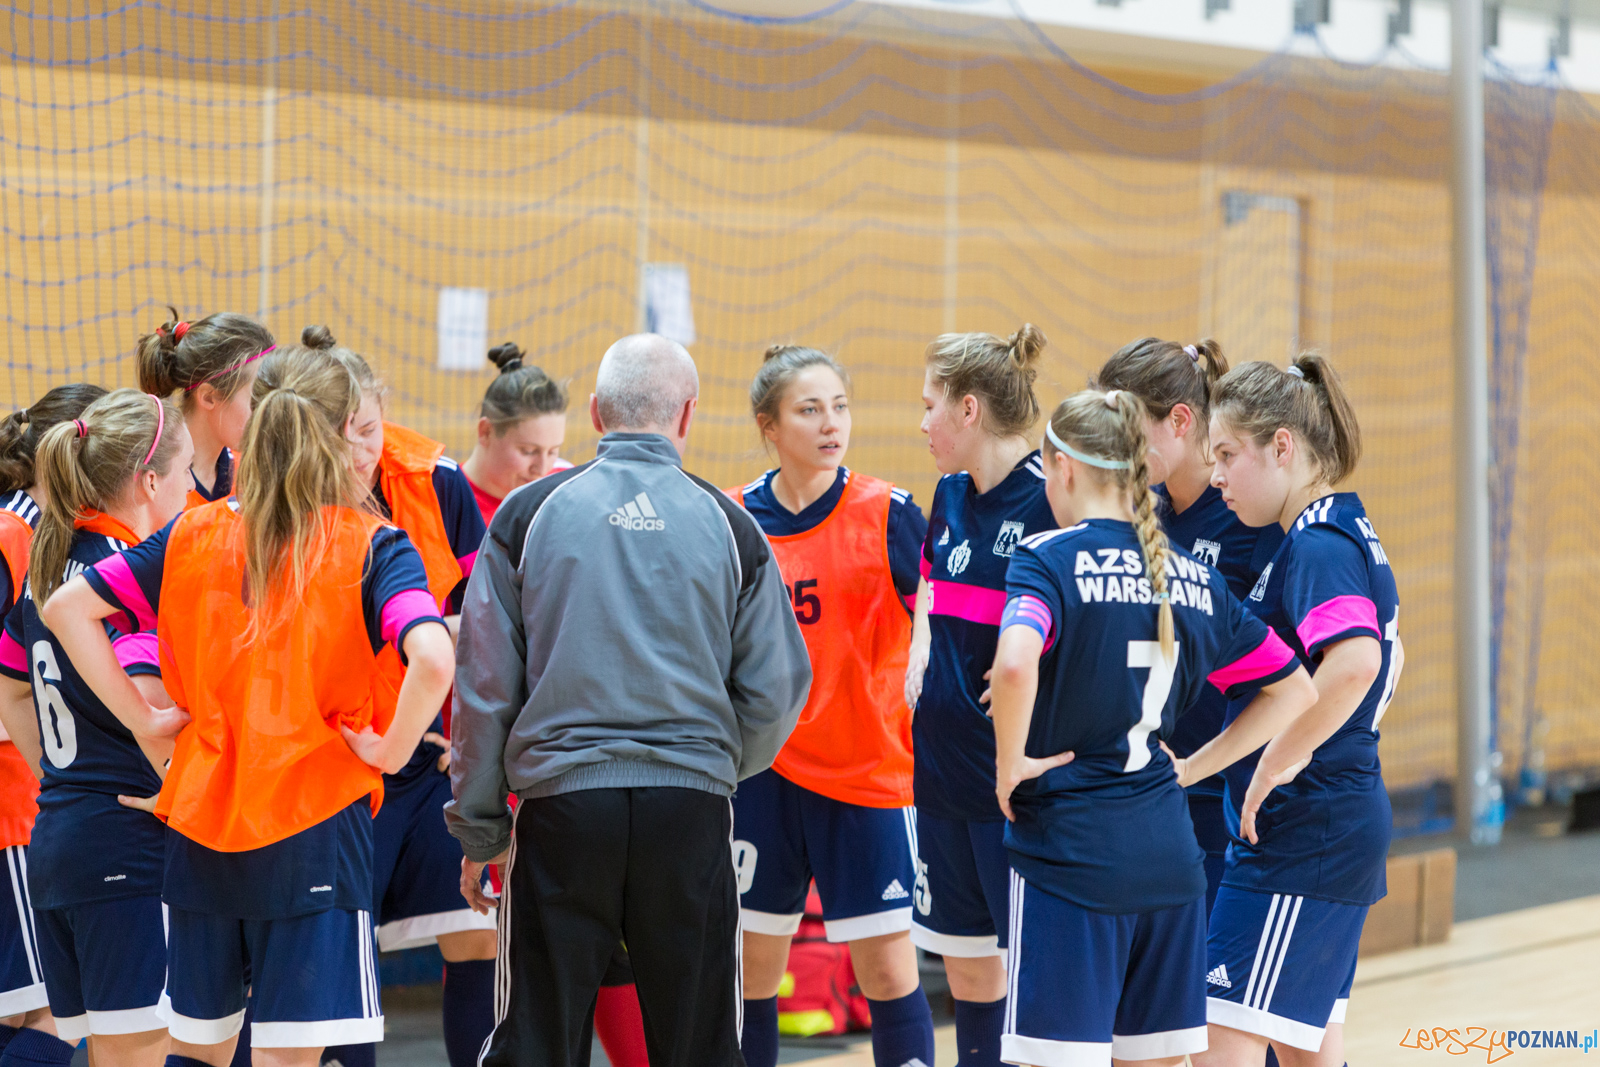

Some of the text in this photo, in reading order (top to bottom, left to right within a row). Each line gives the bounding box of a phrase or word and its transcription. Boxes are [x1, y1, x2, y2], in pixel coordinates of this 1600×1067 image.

[608, 513, 666, 531] adidas
[1074, 548, 1143, 576] AZS
[784, 577, 821, 625] 5
[32, 640, 78, 769] 6
[1123, 640, 1180, 773] 7
[881, 890, 909, 900] adidas
